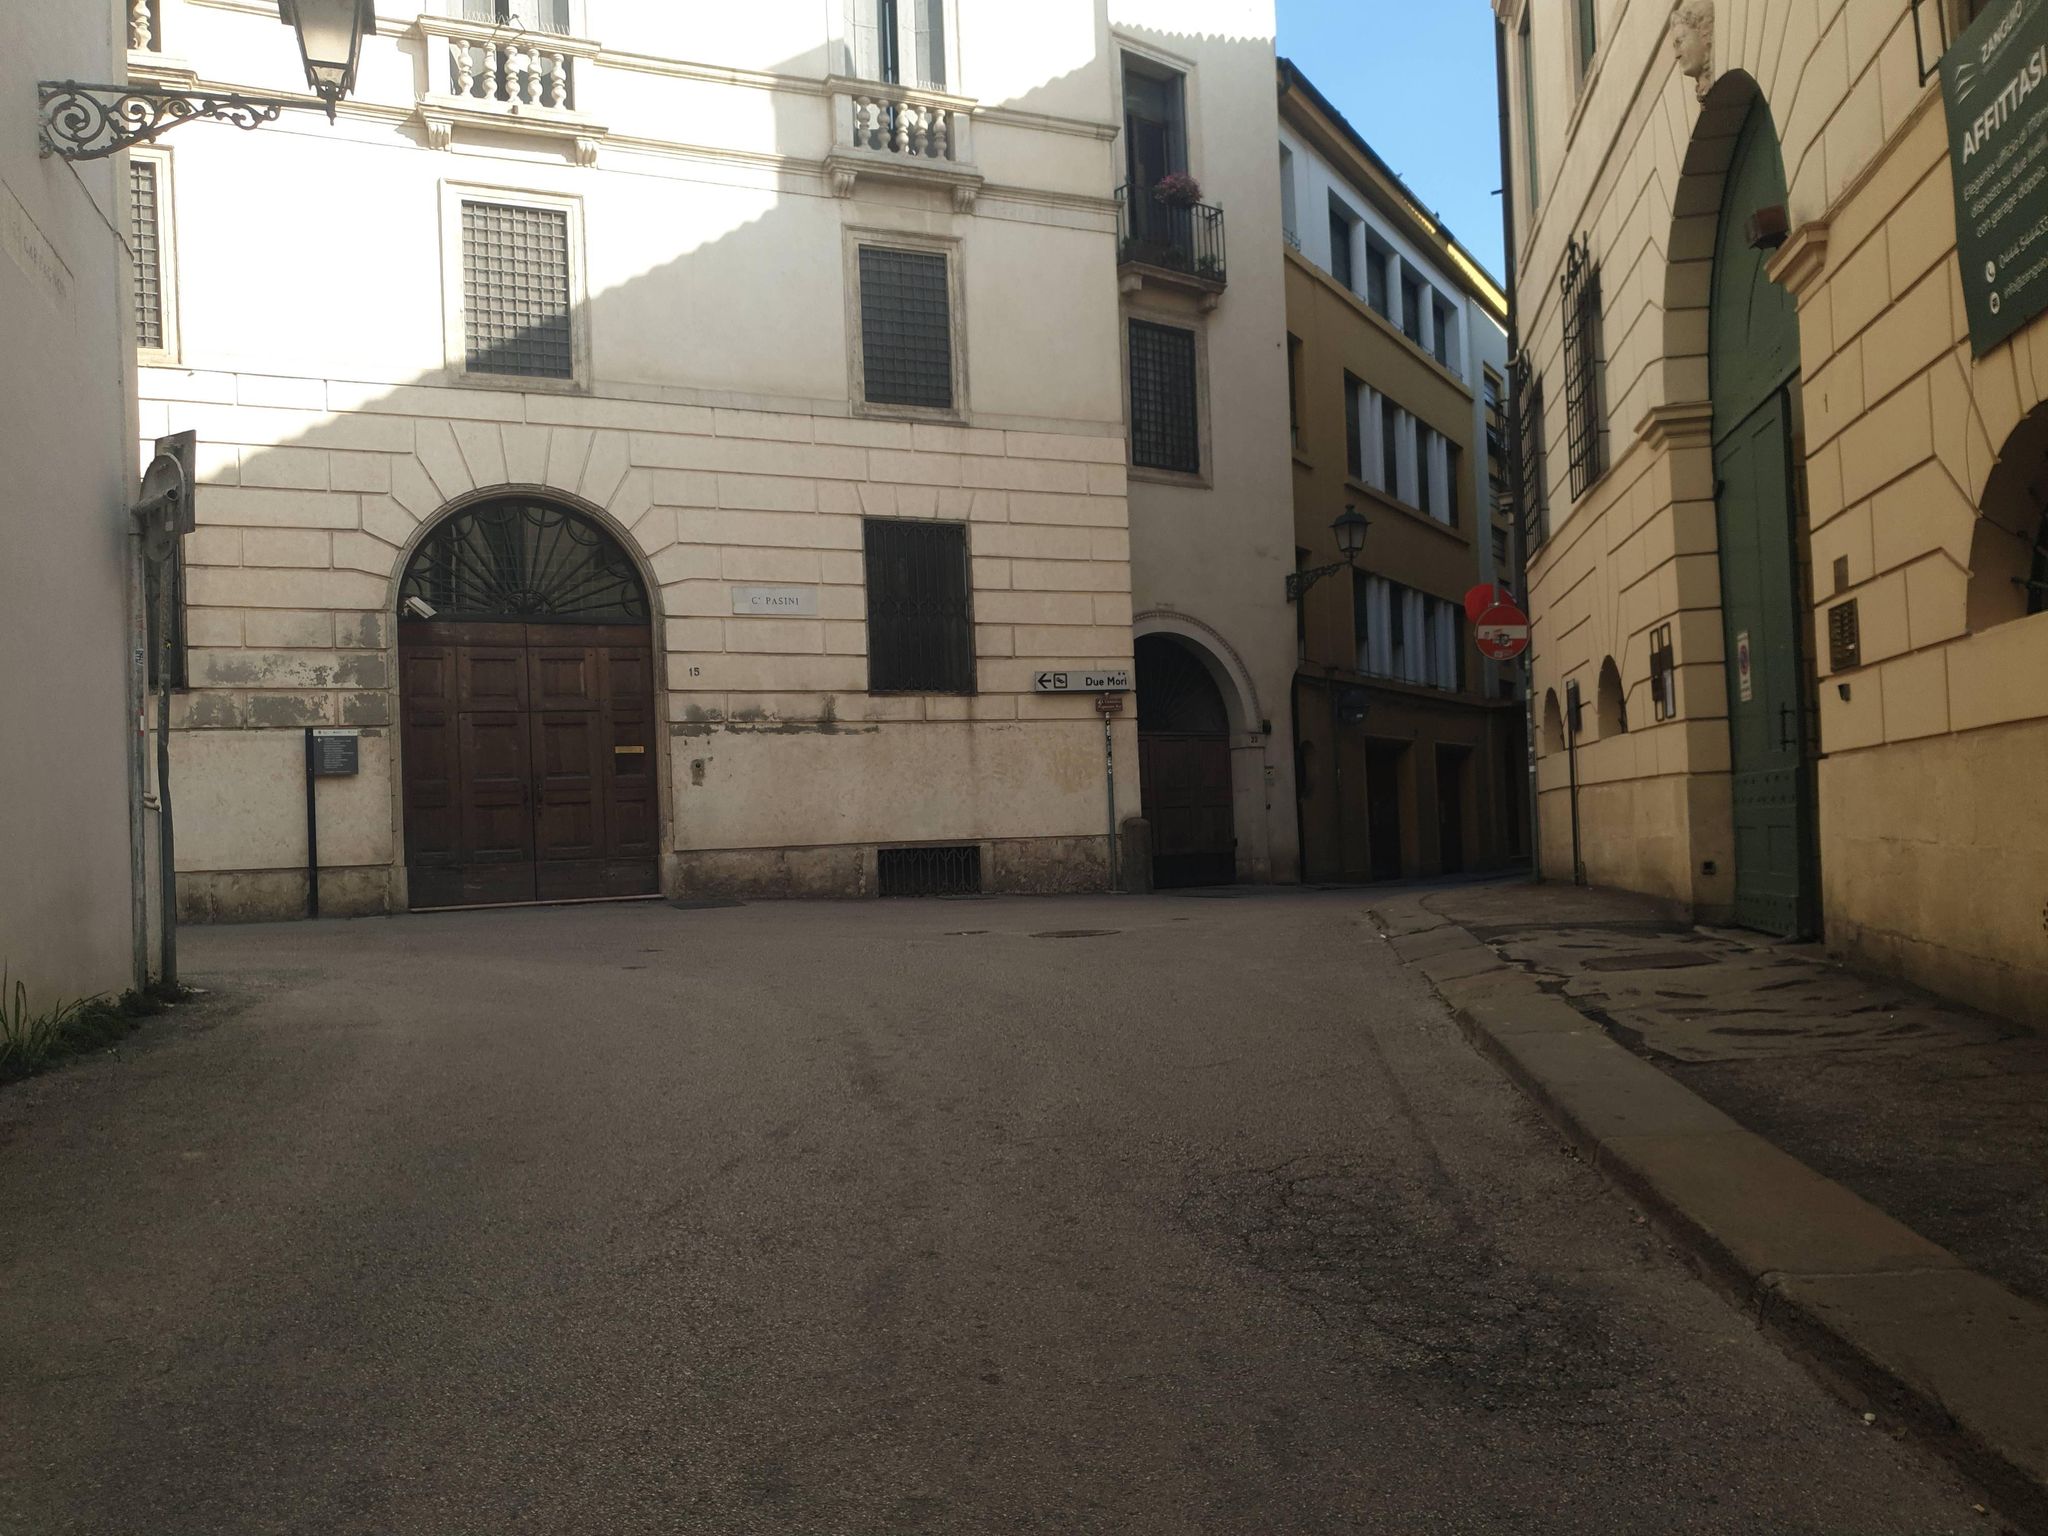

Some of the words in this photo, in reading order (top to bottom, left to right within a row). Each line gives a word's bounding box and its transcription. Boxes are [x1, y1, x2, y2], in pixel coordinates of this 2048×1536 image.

[1962, 45, 2047, 166] AFFITTASI
[765, 596, 799, 606] PASINI
[689, 667, 700, 677] 15
[1085, 676, 1105, 687] Due
[1107, 676, 1127, 686] Mori
